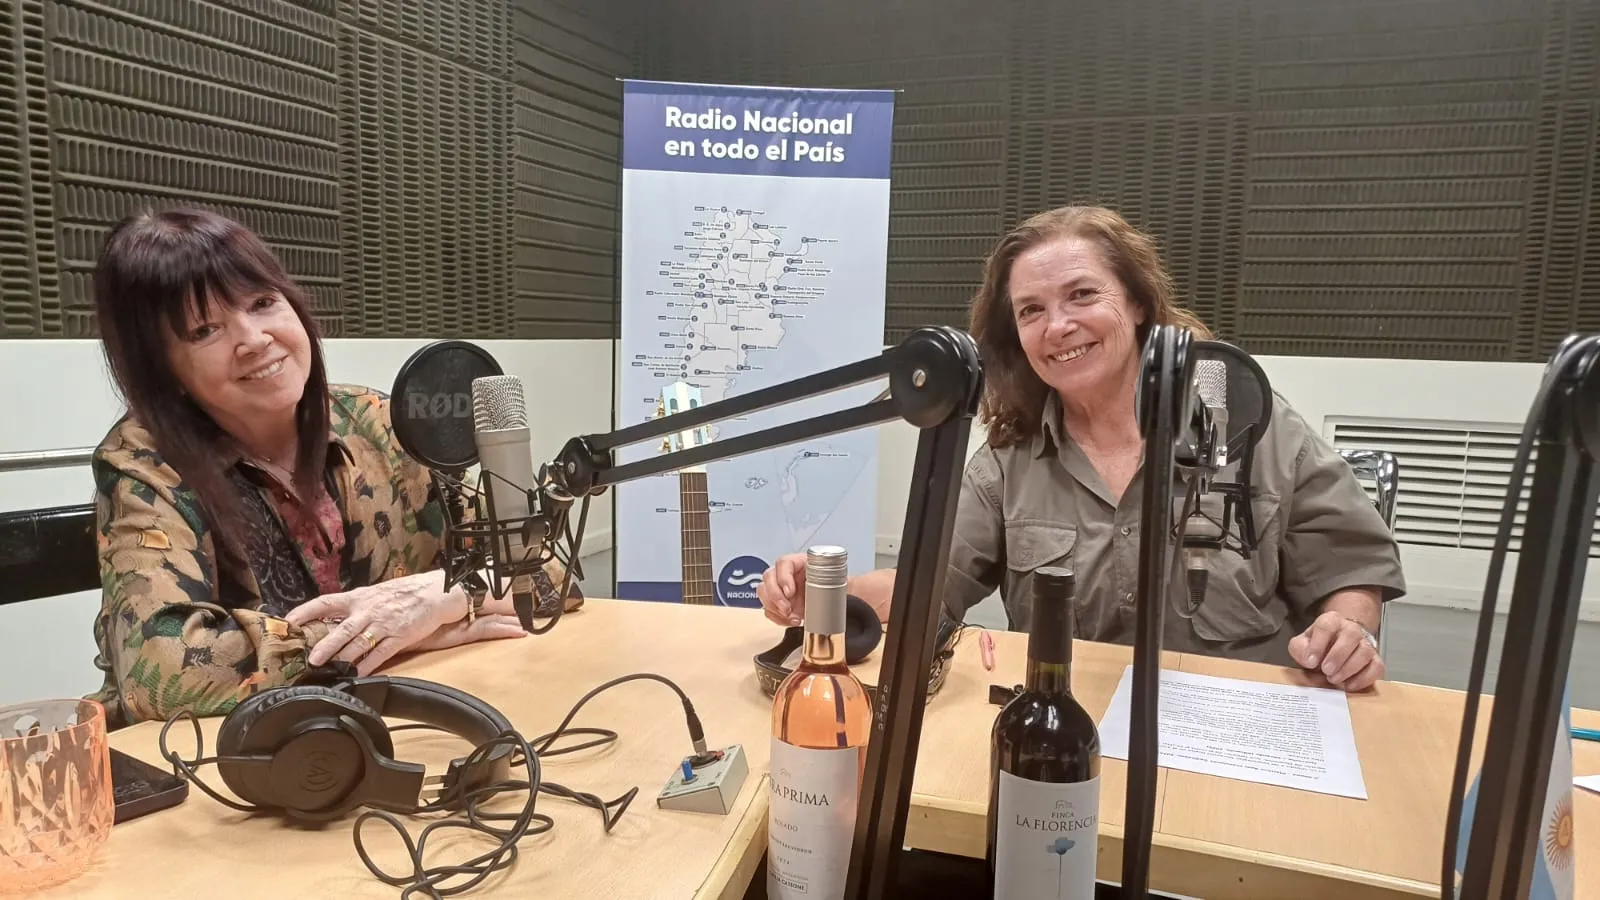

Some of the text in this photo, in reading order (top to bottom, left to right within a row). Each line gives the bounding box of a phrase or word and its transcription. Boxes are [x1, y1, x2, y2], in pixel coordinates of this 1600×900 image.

[665, 106, 853, 135] Radio Nacional
[664, 138, 845, 163] en todo el País
[1016, 814, 1031, 829] LA
[1051, 811, 1075, 819] FINCA
